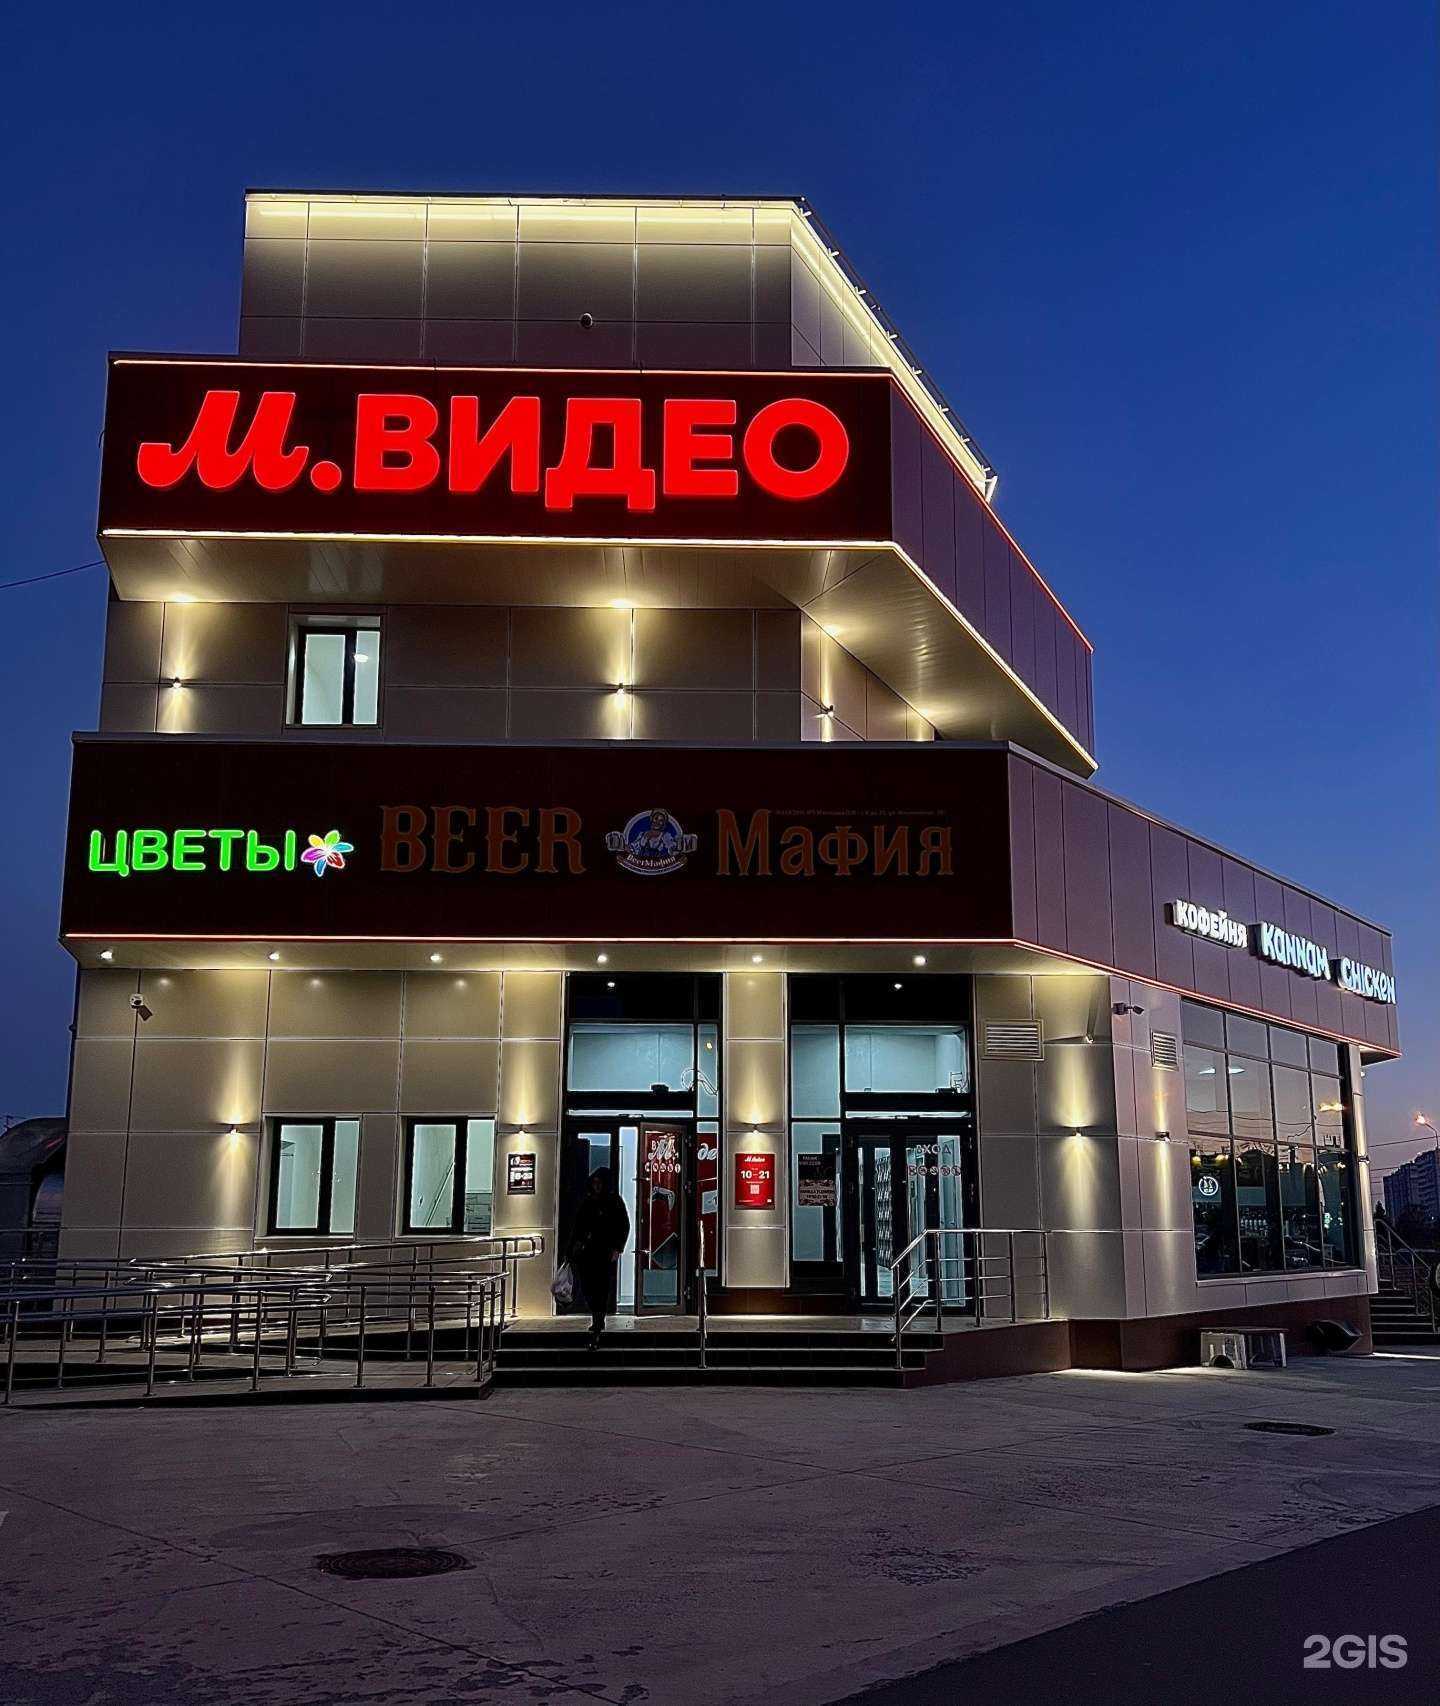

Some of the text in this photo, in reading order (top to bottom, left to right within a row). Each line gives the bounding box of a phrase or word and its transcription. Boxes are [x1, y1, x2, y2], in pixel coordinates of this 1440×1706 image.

[89, 830, 296, 877] ЦВЕТЫ
[380, 805, 587, 874] BEER
[1173, 899, 1248, 949] КОФЕЙНЯ
